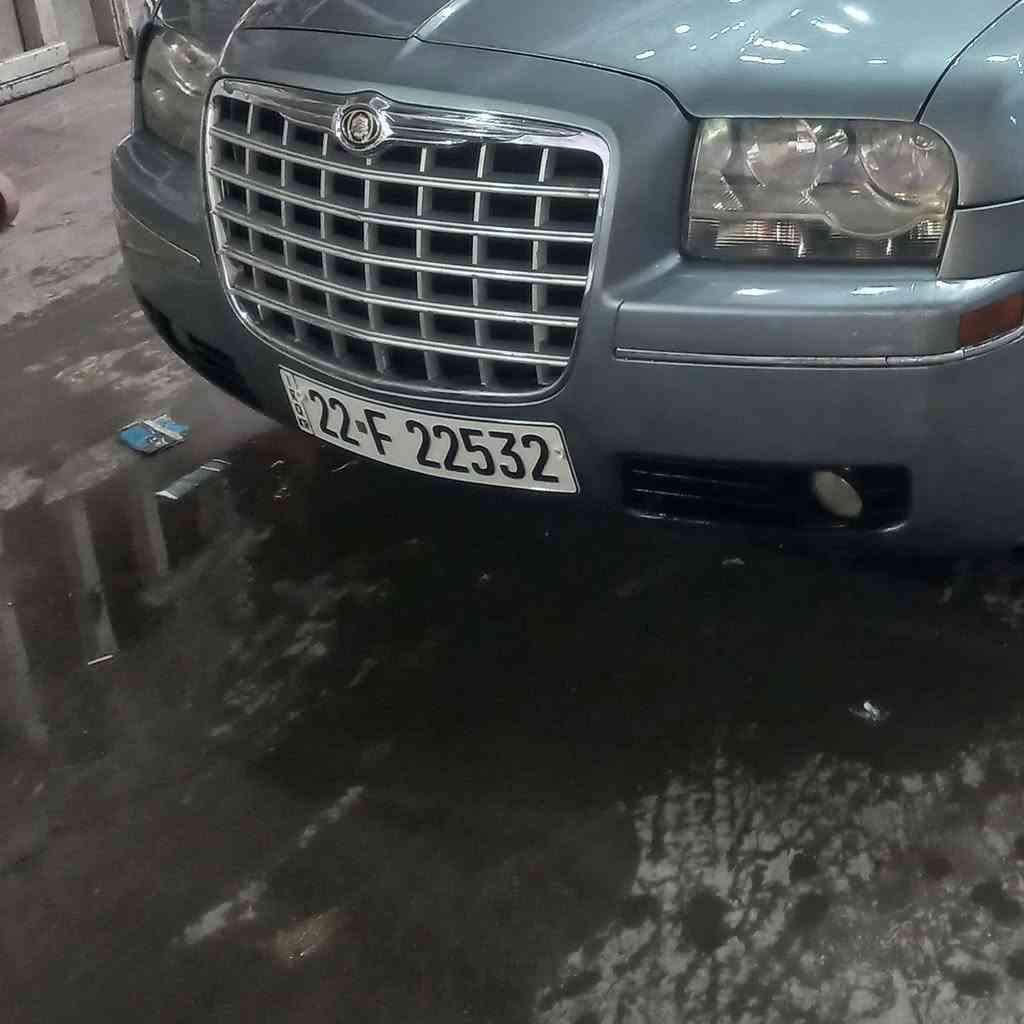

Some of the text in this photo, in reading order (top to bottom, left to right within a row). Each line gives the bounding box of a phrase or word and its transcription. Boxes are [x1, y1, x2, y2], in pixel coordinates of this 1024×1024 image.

[309, 389, 560, 484] 22 F 22532
